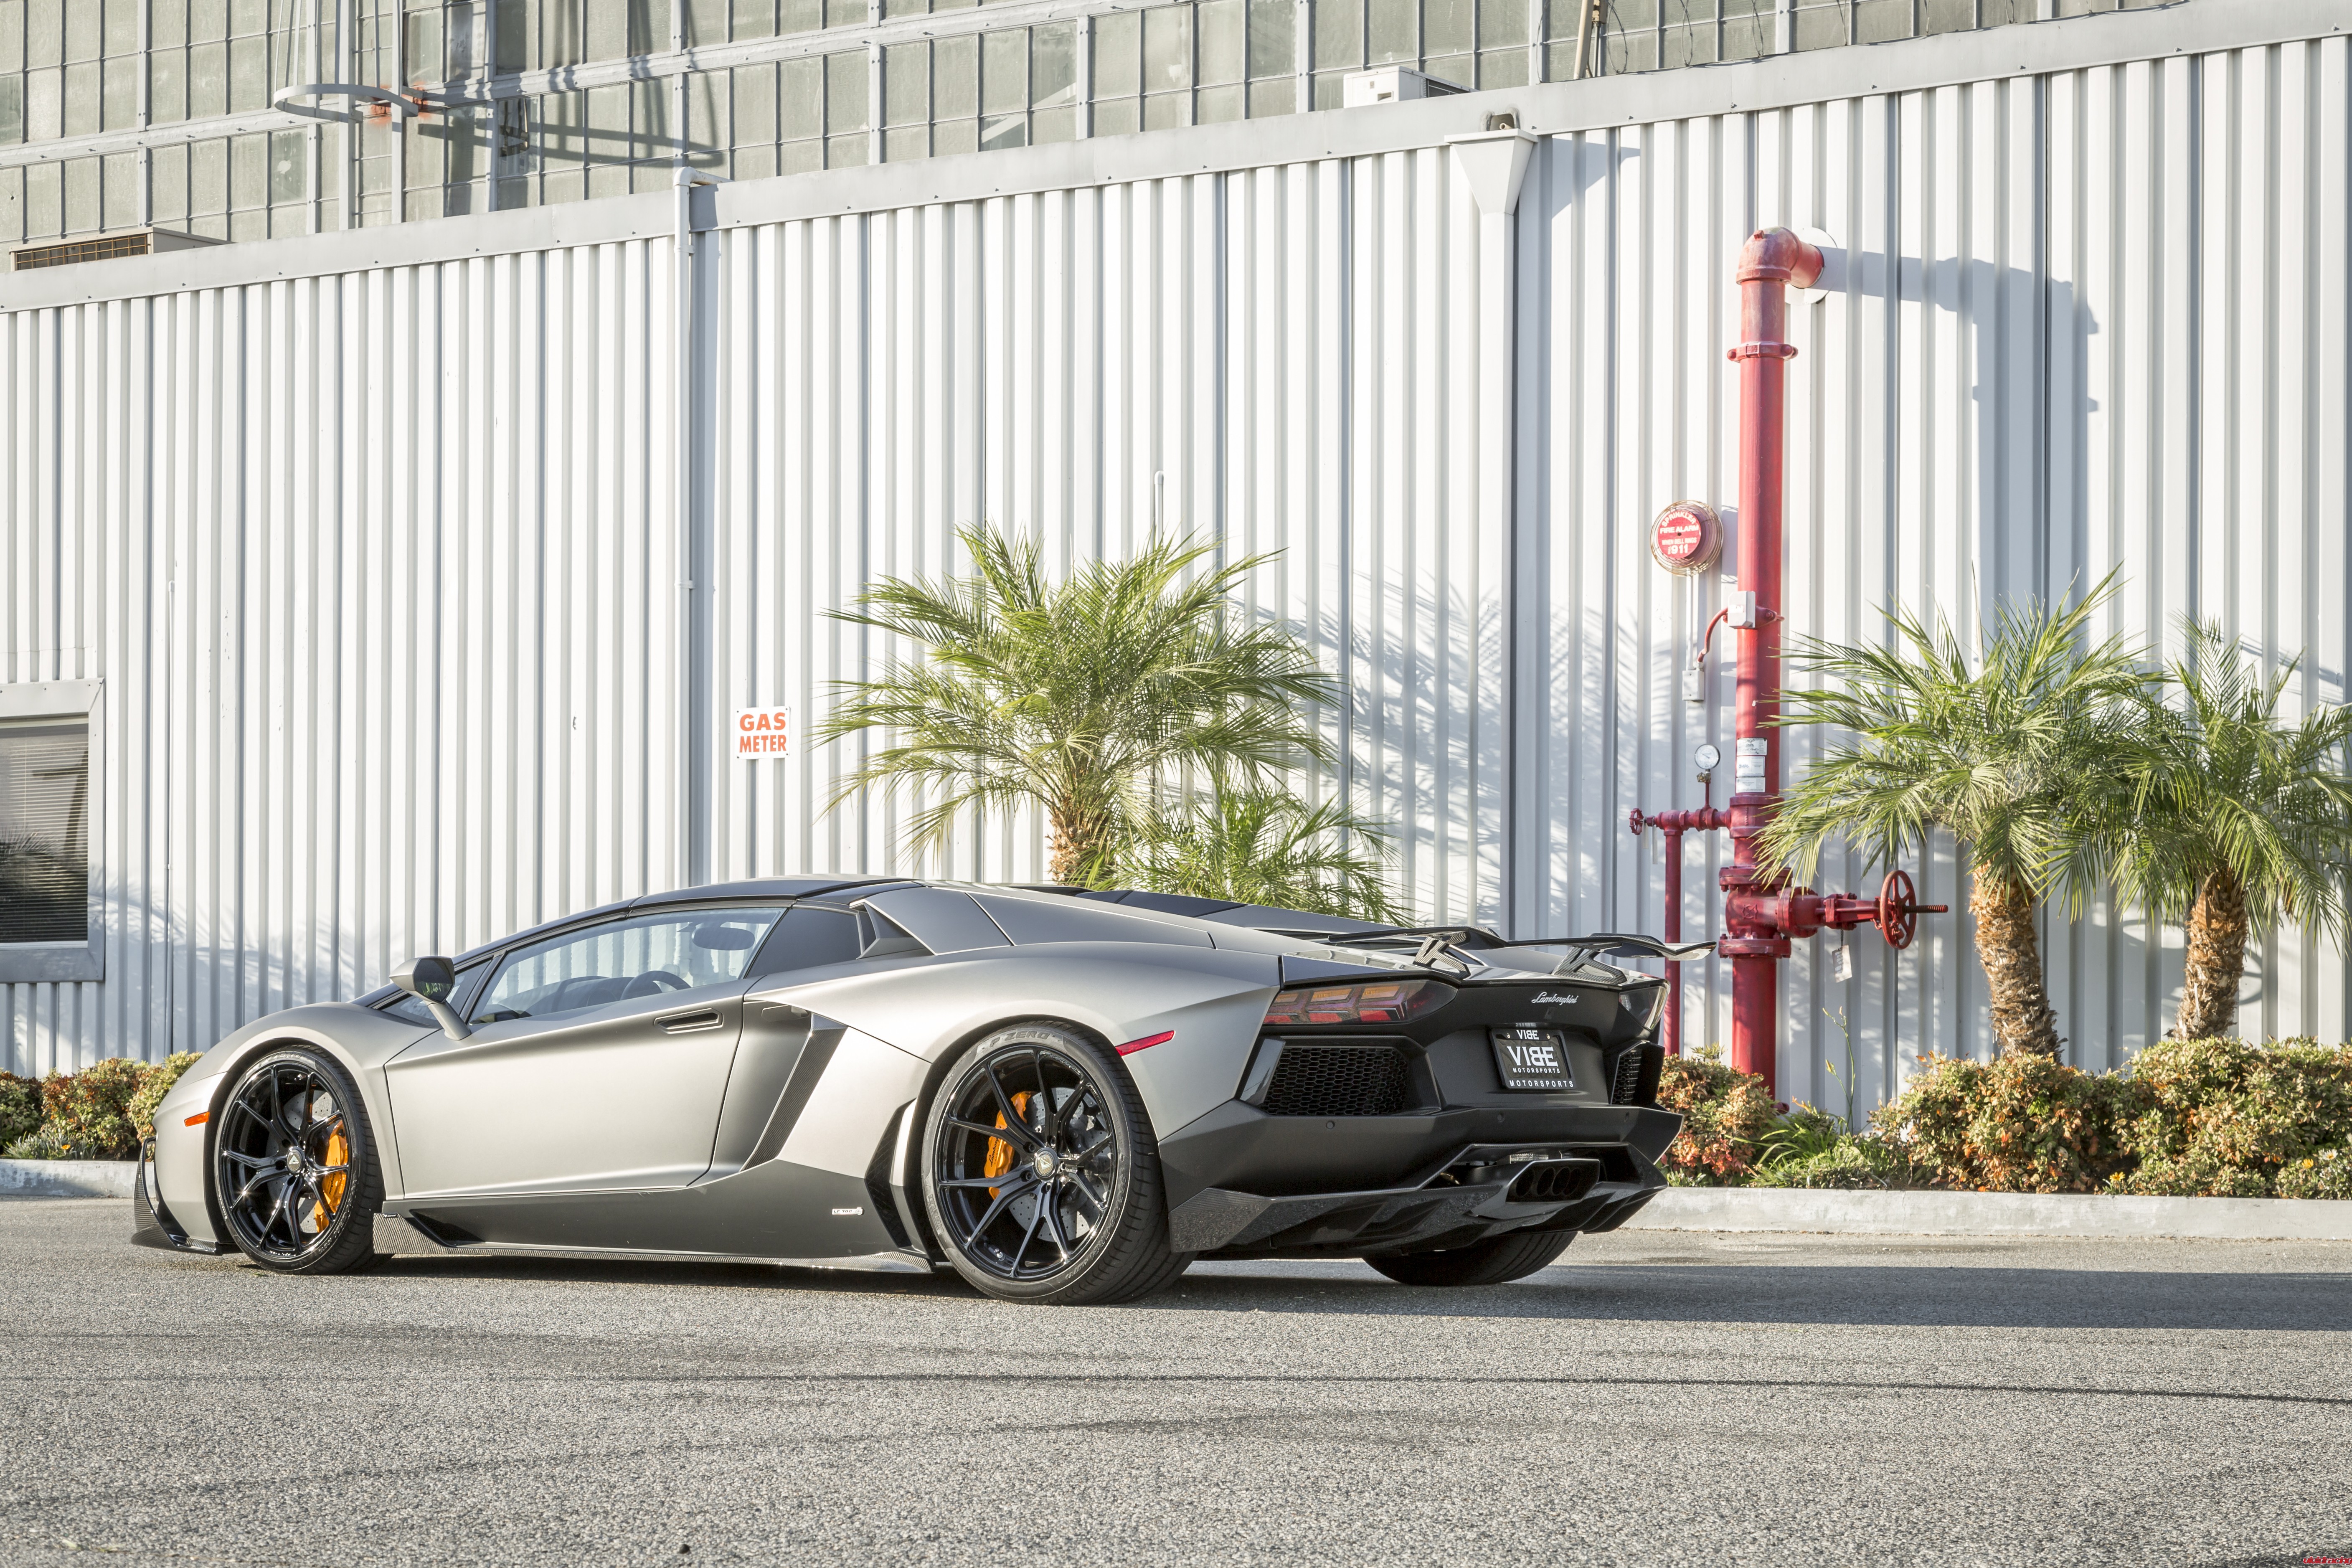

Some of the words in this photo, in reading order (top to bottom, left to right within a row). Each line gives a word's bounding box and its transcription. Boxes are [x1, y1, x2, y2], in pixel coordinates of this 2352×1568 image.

[1661, 511, 1697, 527] SPRINKLER
[1671, 544, 1688, 554] 911
[740, 712, 786, 731] GAS
[739, 735, 787, 753] METER
[1531, 992, 1579, 1005] Lamborghini
[990, 1037, 1000, 1048] P
[1005, 1030, 1050, 1041] ZERO
[1517, 1030, 1539, 1040] VIBE
[1507, 1046, 1558, 1067] VIBE
